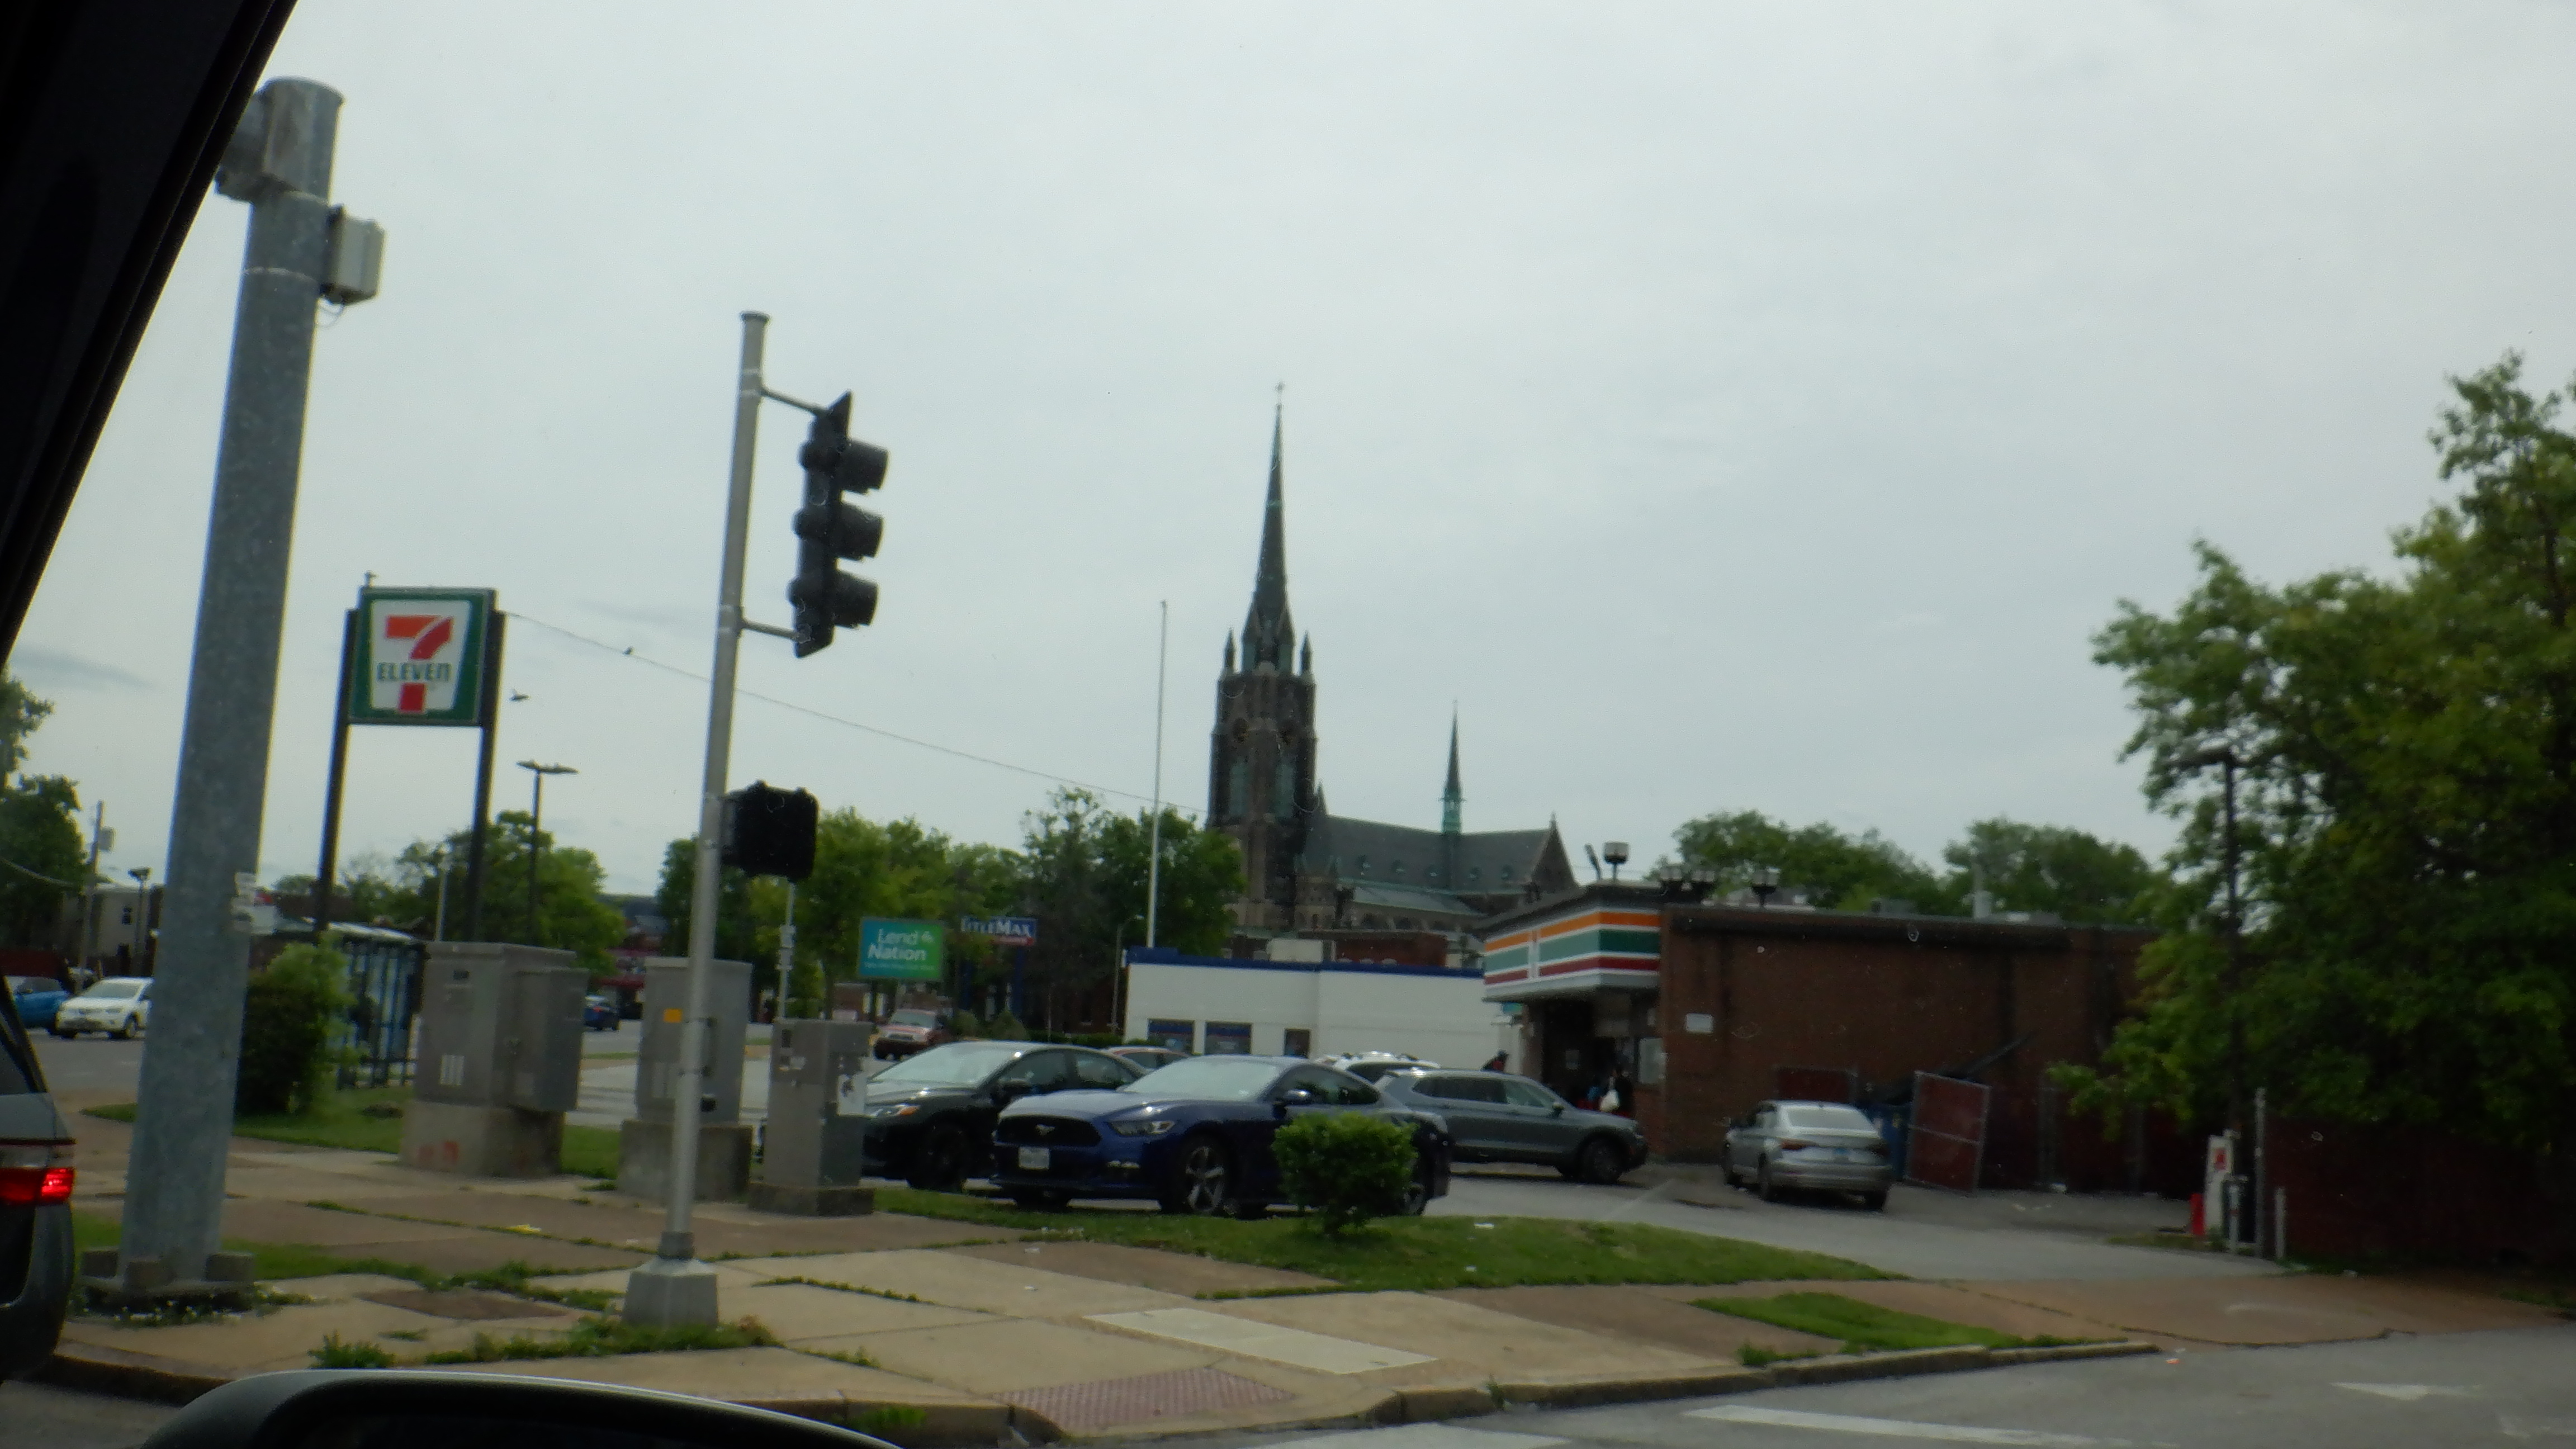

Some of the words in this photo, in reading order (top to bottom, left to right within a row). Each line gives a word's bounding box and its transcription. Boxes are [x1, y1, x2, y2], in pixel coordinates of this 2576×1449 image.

[385, 614, 453, 714] 7
[878, 928, 918, 945] Lend
[867, 943, 927, 960] Nation
